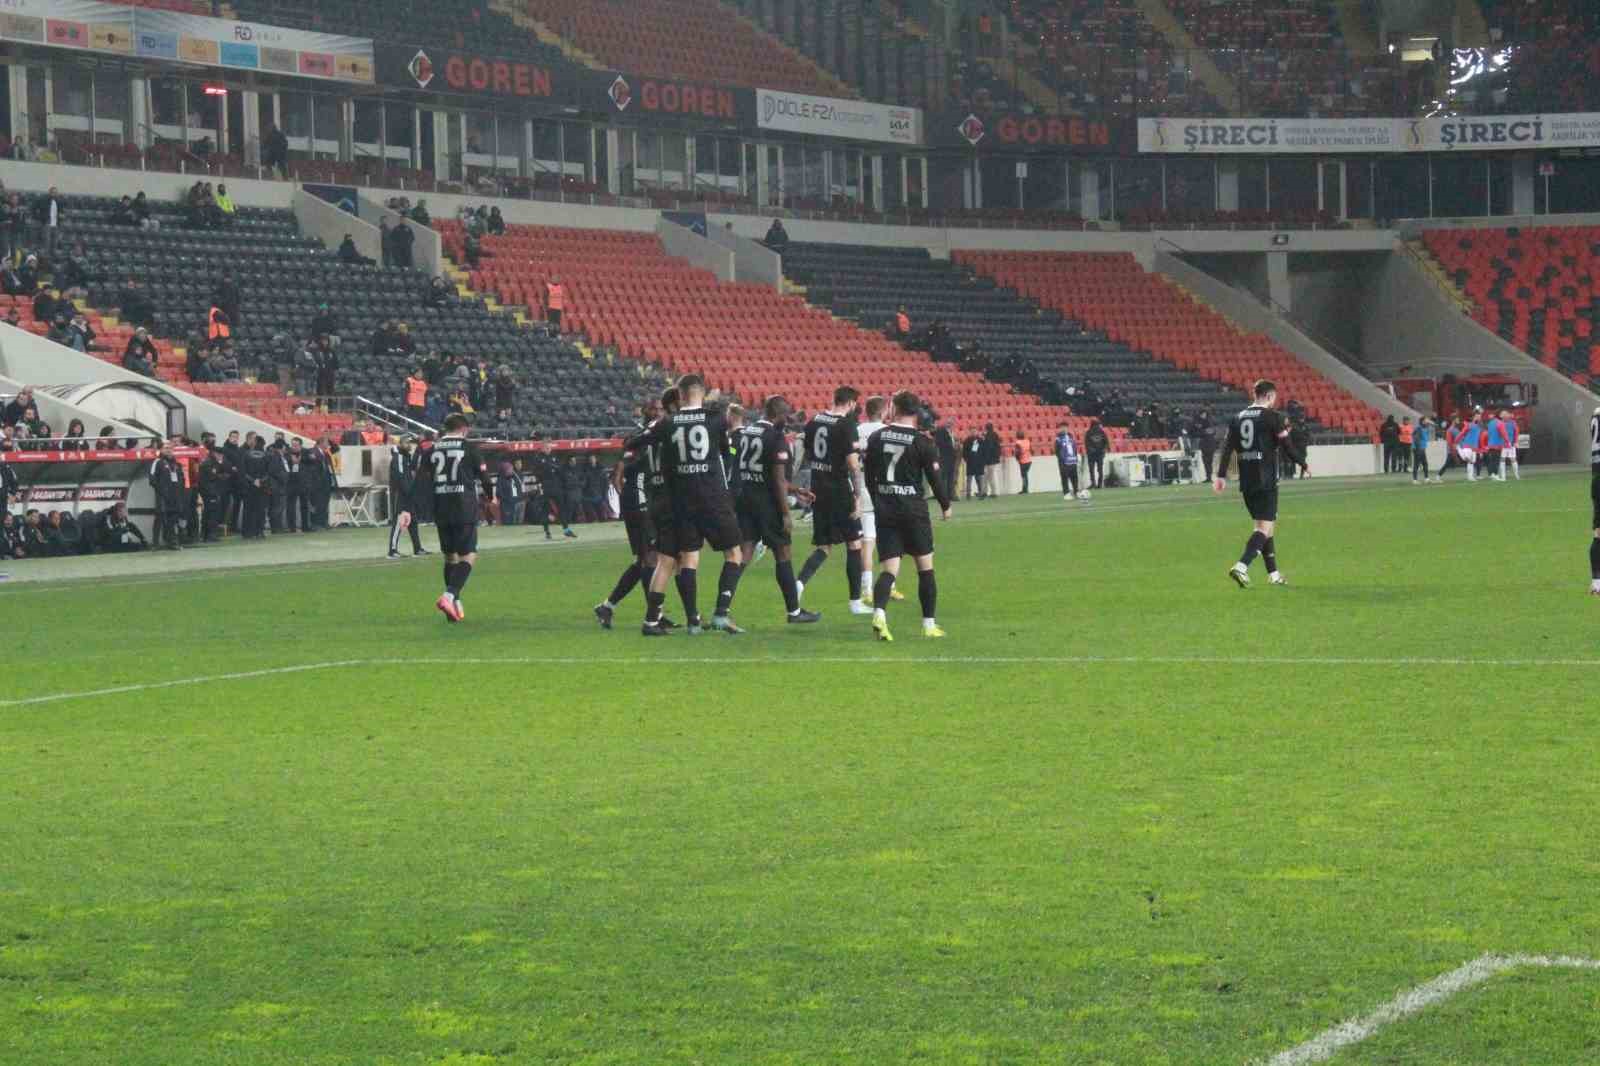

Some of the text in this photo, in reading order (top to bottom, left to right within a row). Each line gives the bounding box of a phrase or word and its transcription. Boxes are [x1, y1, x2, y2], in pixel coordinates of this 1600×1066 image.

[1183, 119, 1279, 152] ŞİRECİ
[1440, 116, 1544, 150] ŞİRECİ
[671, 424, 710, 463] 19
[813, 425, 829, 459] 6
[1240, 419, 1254, 450] 9
[430, 450, 465, 482] 27
[738, 434, 764, 473] 22
[882, 443, 906, 482] 7
